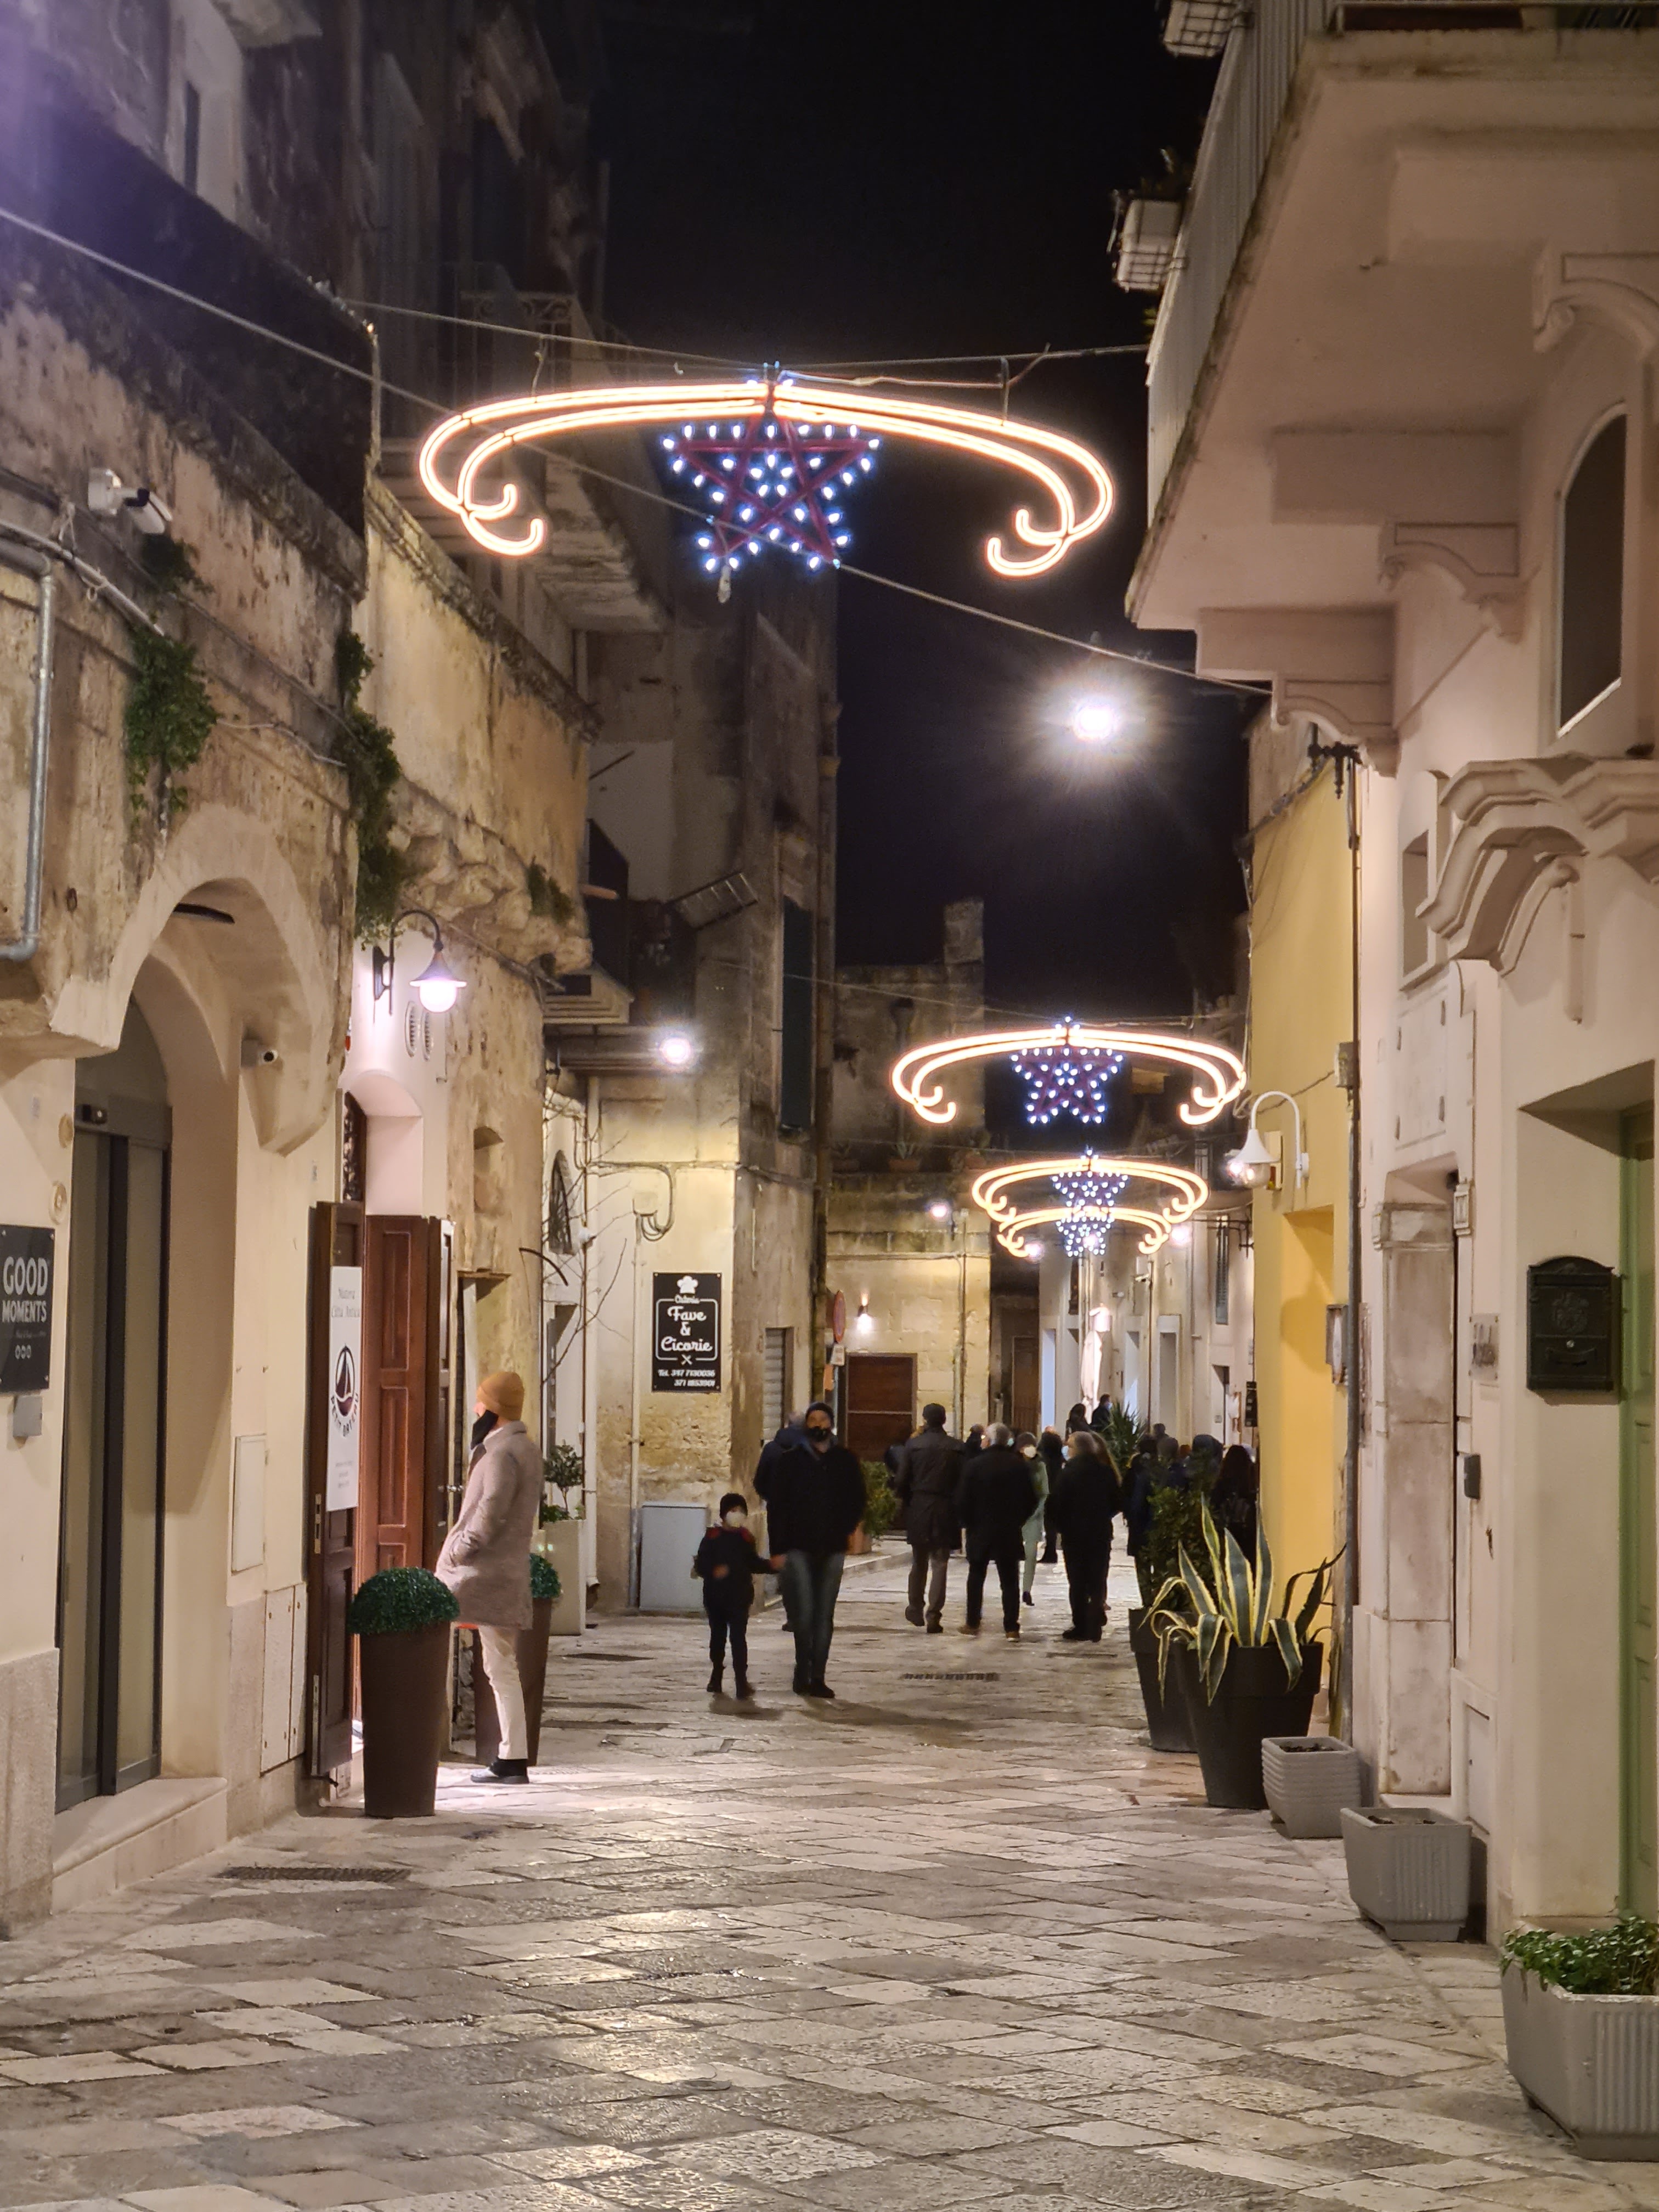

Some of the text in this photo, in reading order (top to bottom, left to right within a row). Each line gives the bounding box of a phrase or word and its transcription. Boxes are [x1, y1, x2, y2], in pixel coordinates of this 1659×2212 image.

[3, 1256, 48, 1296] GOOD
[2, 1300, 47, 1323] MOMENTS
[667, 1306, 707, 1322] Fave
[680, 1321, 691, 1336] &
[661, 1336, 713, 1352] Cicorie
